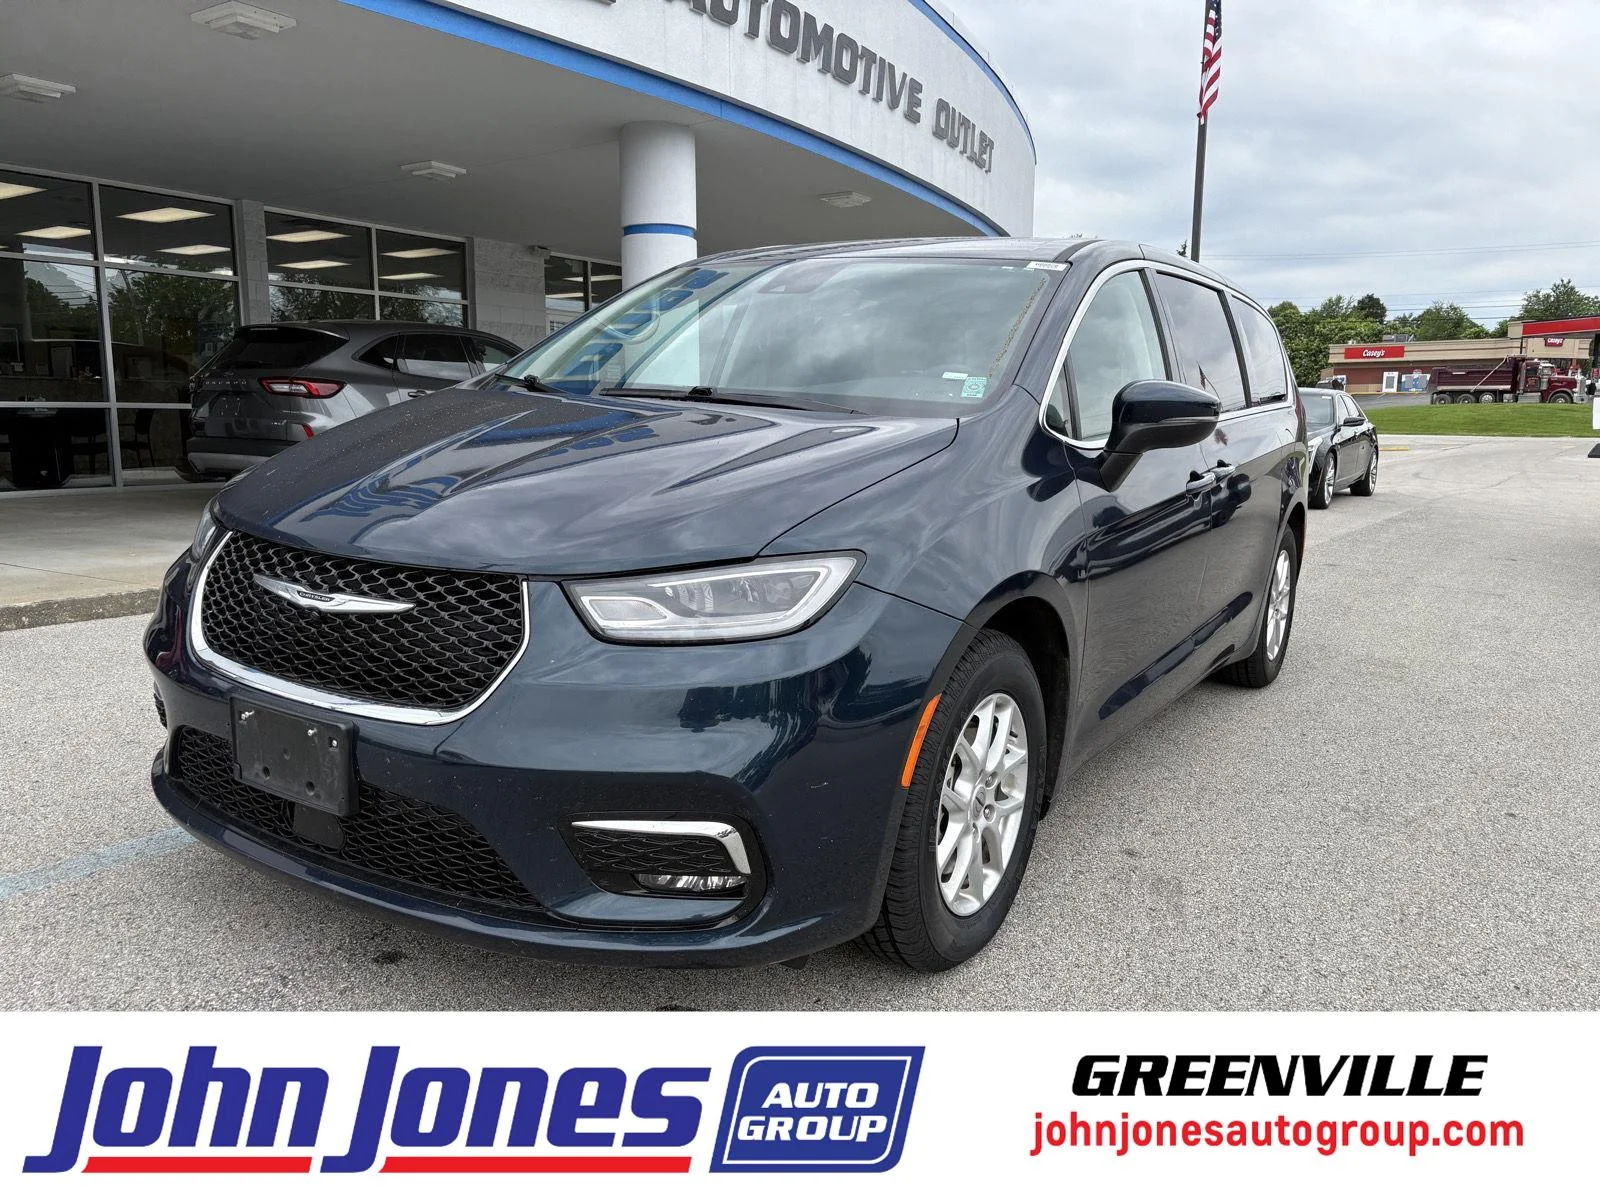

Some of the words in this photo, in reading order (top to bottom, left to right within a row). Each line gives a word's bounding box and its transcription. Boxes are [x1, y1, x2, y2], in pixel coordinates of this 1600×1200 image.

[660, 0, 923, 124] TOMOTIVE
[932, 98, 995, 174] OUTLET
[1362, 349, 1386, 358] Casey's
[299, 591, 331, 602] CHRYSLER
